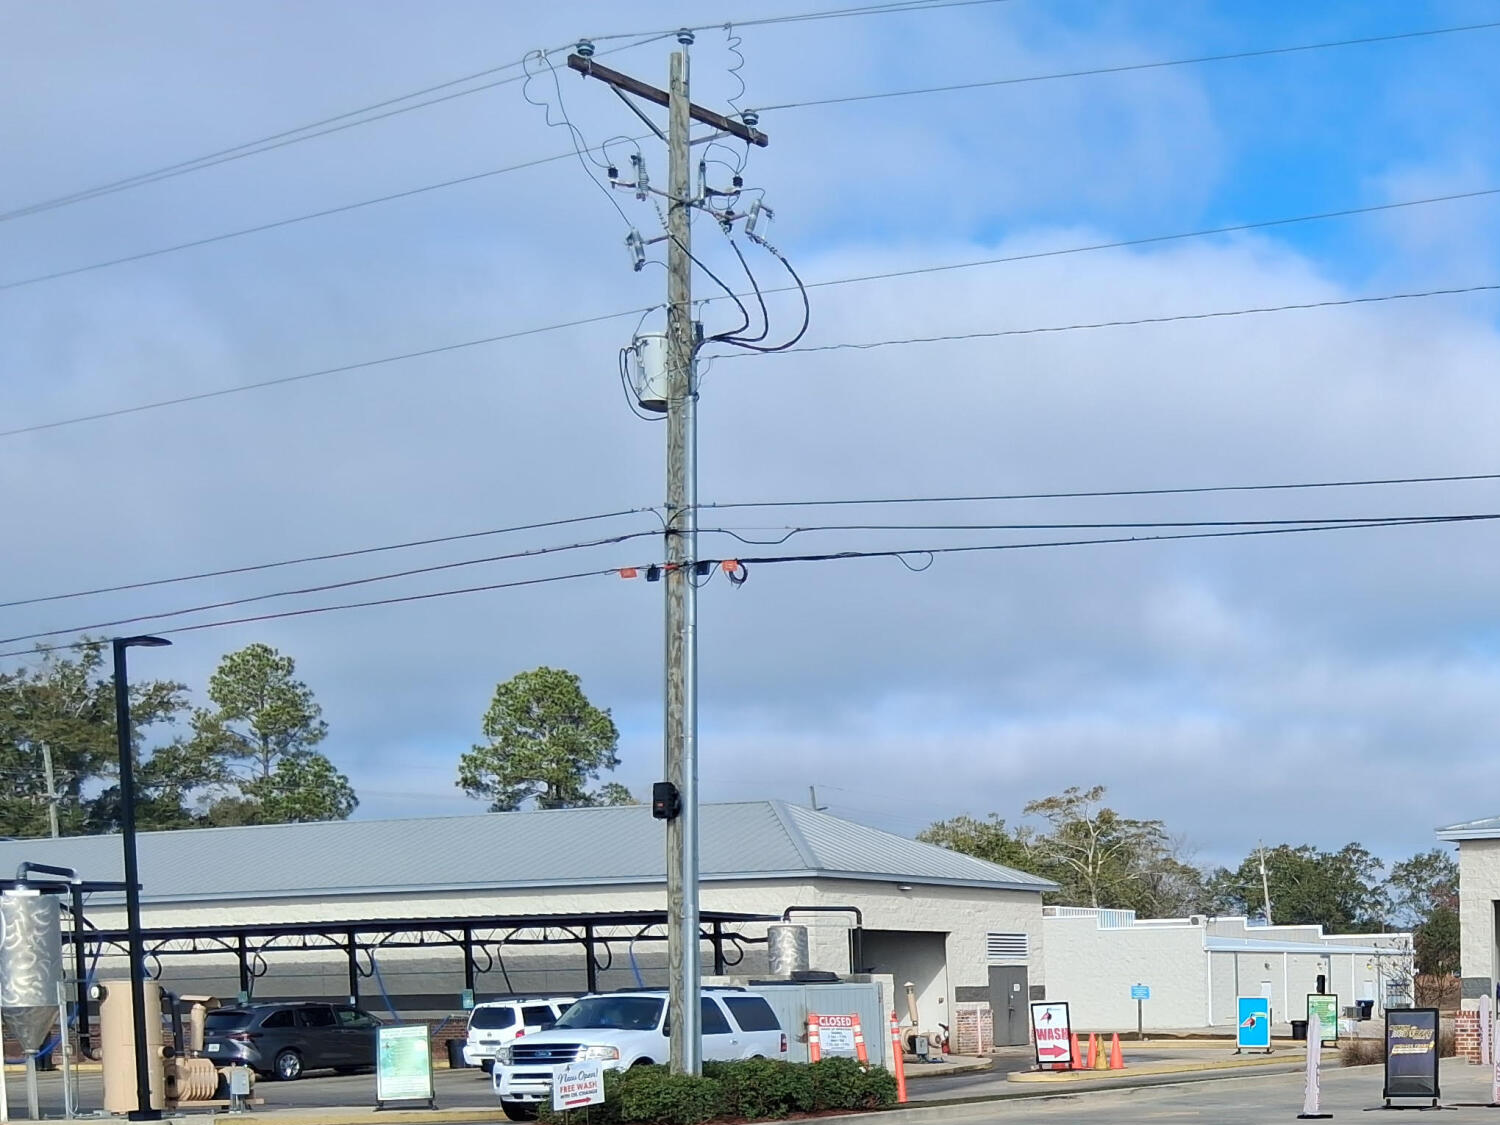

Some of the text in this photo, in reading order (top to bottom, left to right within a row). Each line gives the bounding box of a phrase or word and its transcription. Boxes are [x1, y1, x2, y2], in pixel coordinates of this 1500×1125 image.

[819, 1016, 852, 1026] CLOSED
[1036, 1028, 1071, 1041] WASH
[558, 1068, 599, 1084] Now Open!
[560, 1081, 598, 1093] FREE WASH
